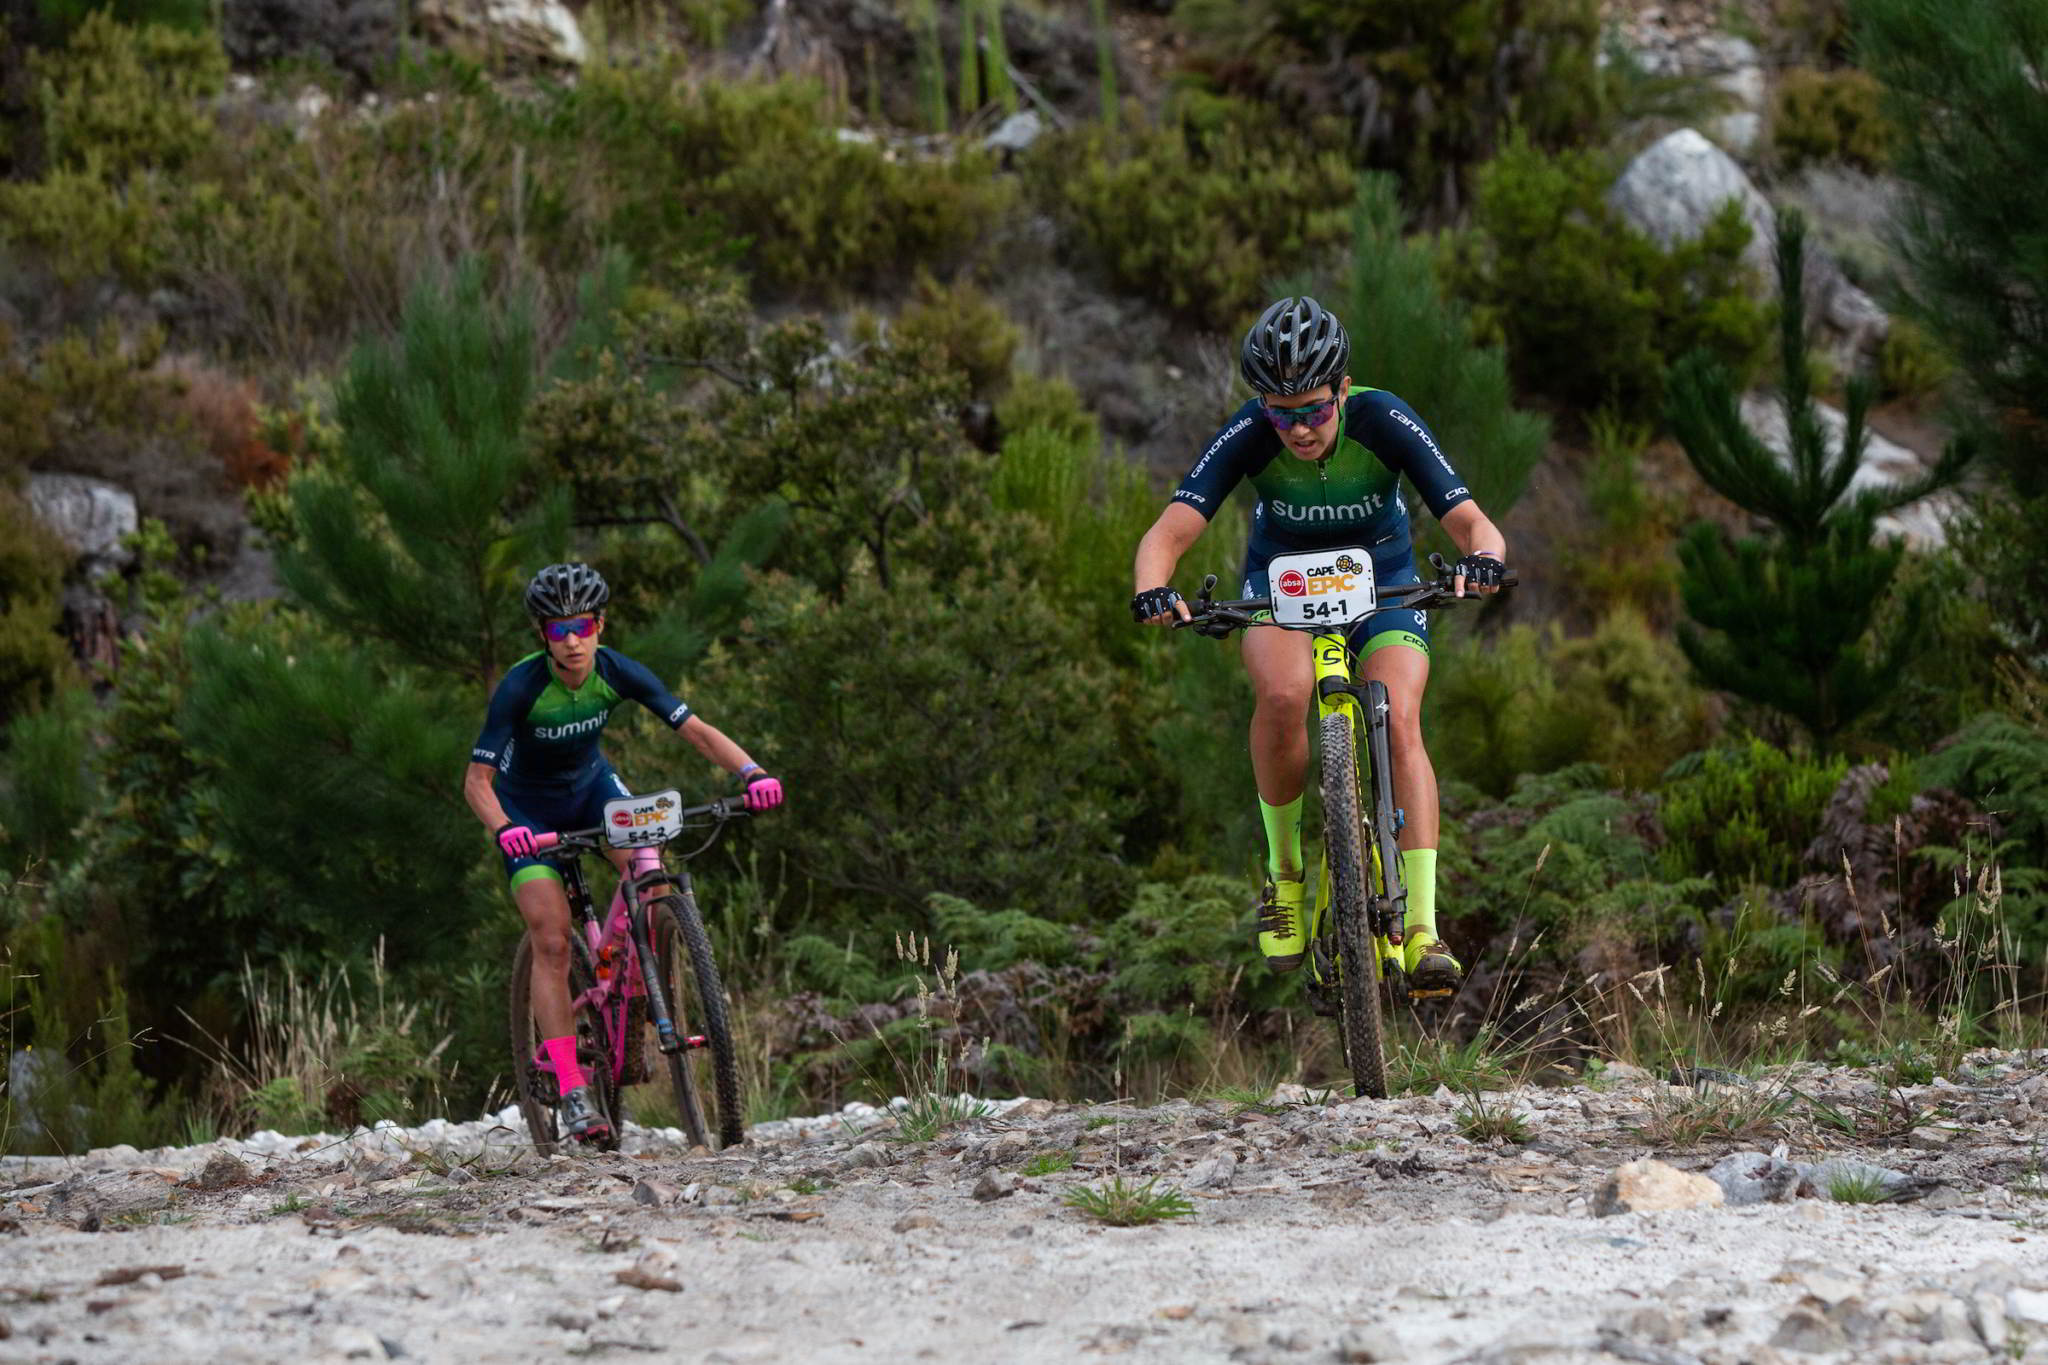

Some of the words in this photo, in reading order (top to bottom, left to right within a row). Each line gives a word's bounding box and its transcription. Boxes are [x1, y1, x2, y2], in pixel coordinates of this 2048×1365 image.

[1191, 417, 1253, 478] cannondale
[1389, 409, 1455, 475] cannondale
[1272, 493, 1383, 521] summit
[1306, 565, 1335, 577] CAPE
[1282, 579, 1302, 588] absa
[1307, 574, 1356, 596] EPIC
[1302, 599, 1348, 620] 54-1
[628, 826, 667, 843] 54-2
